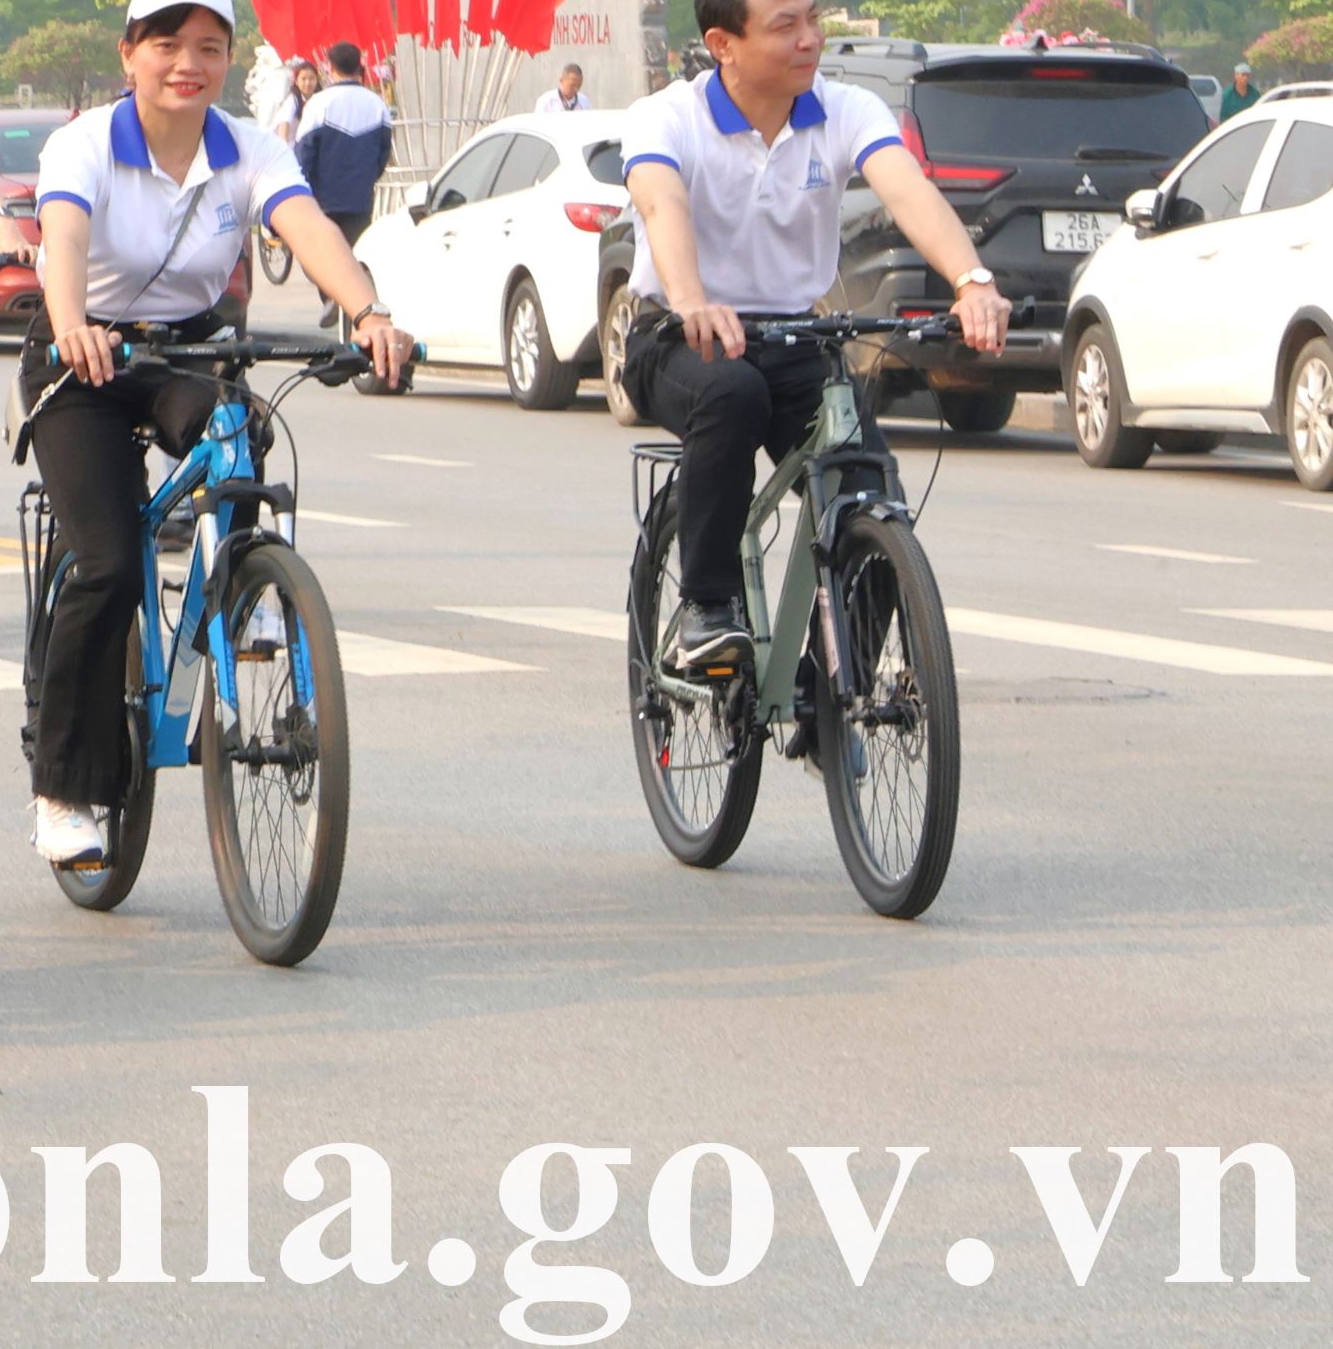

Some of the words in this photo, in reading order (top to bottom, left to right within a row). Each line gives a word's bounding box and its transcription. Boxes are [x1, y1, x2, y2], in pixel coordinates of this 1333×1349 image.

[572, 12, 594, 45] SƠN
[597, 13, 611, 45] LA
[1066, 211, 1101, 231] 26A
[1054, 231, 1112, 250] 215.6
